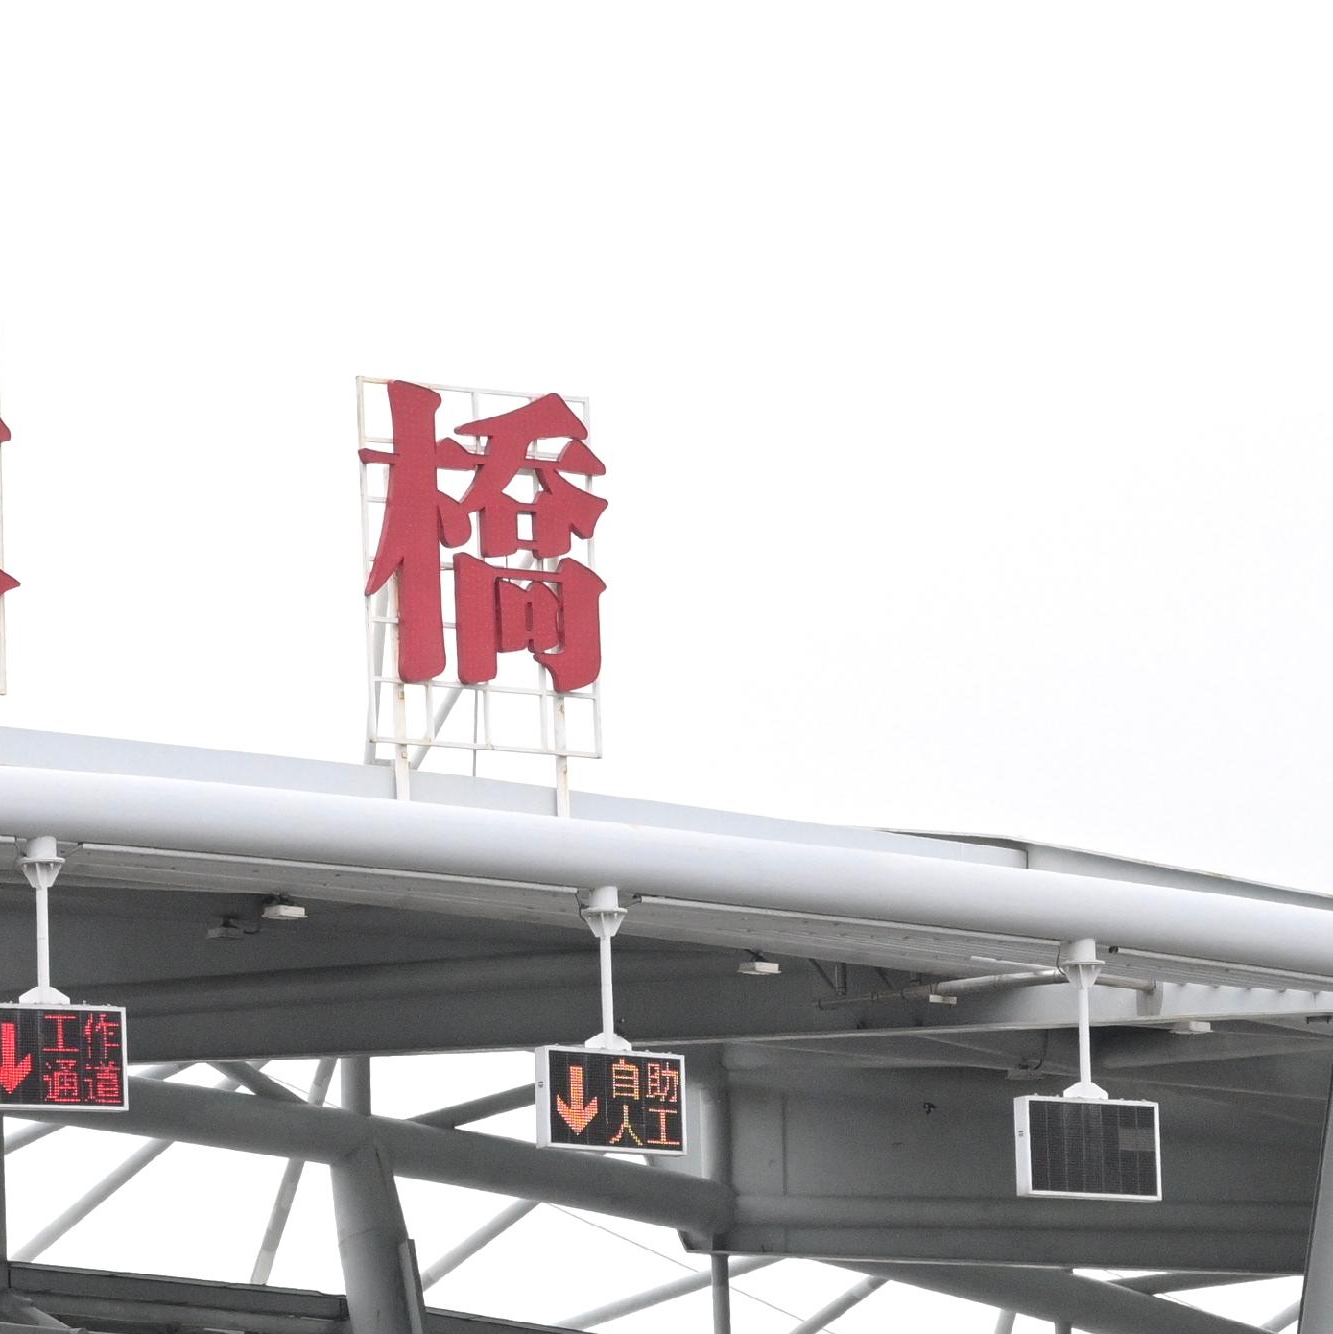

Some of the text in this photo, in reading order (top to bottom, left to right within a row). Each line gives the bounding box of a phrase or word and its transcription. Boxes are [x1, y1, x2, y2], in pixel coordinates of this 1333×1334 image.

[42, 1013, 121, 1060] 工作
[42, 1060, 122, 1104] 通道
[611, 1056, 679, 1103] 自助
[608, 1104, 681, 1146] 人工
